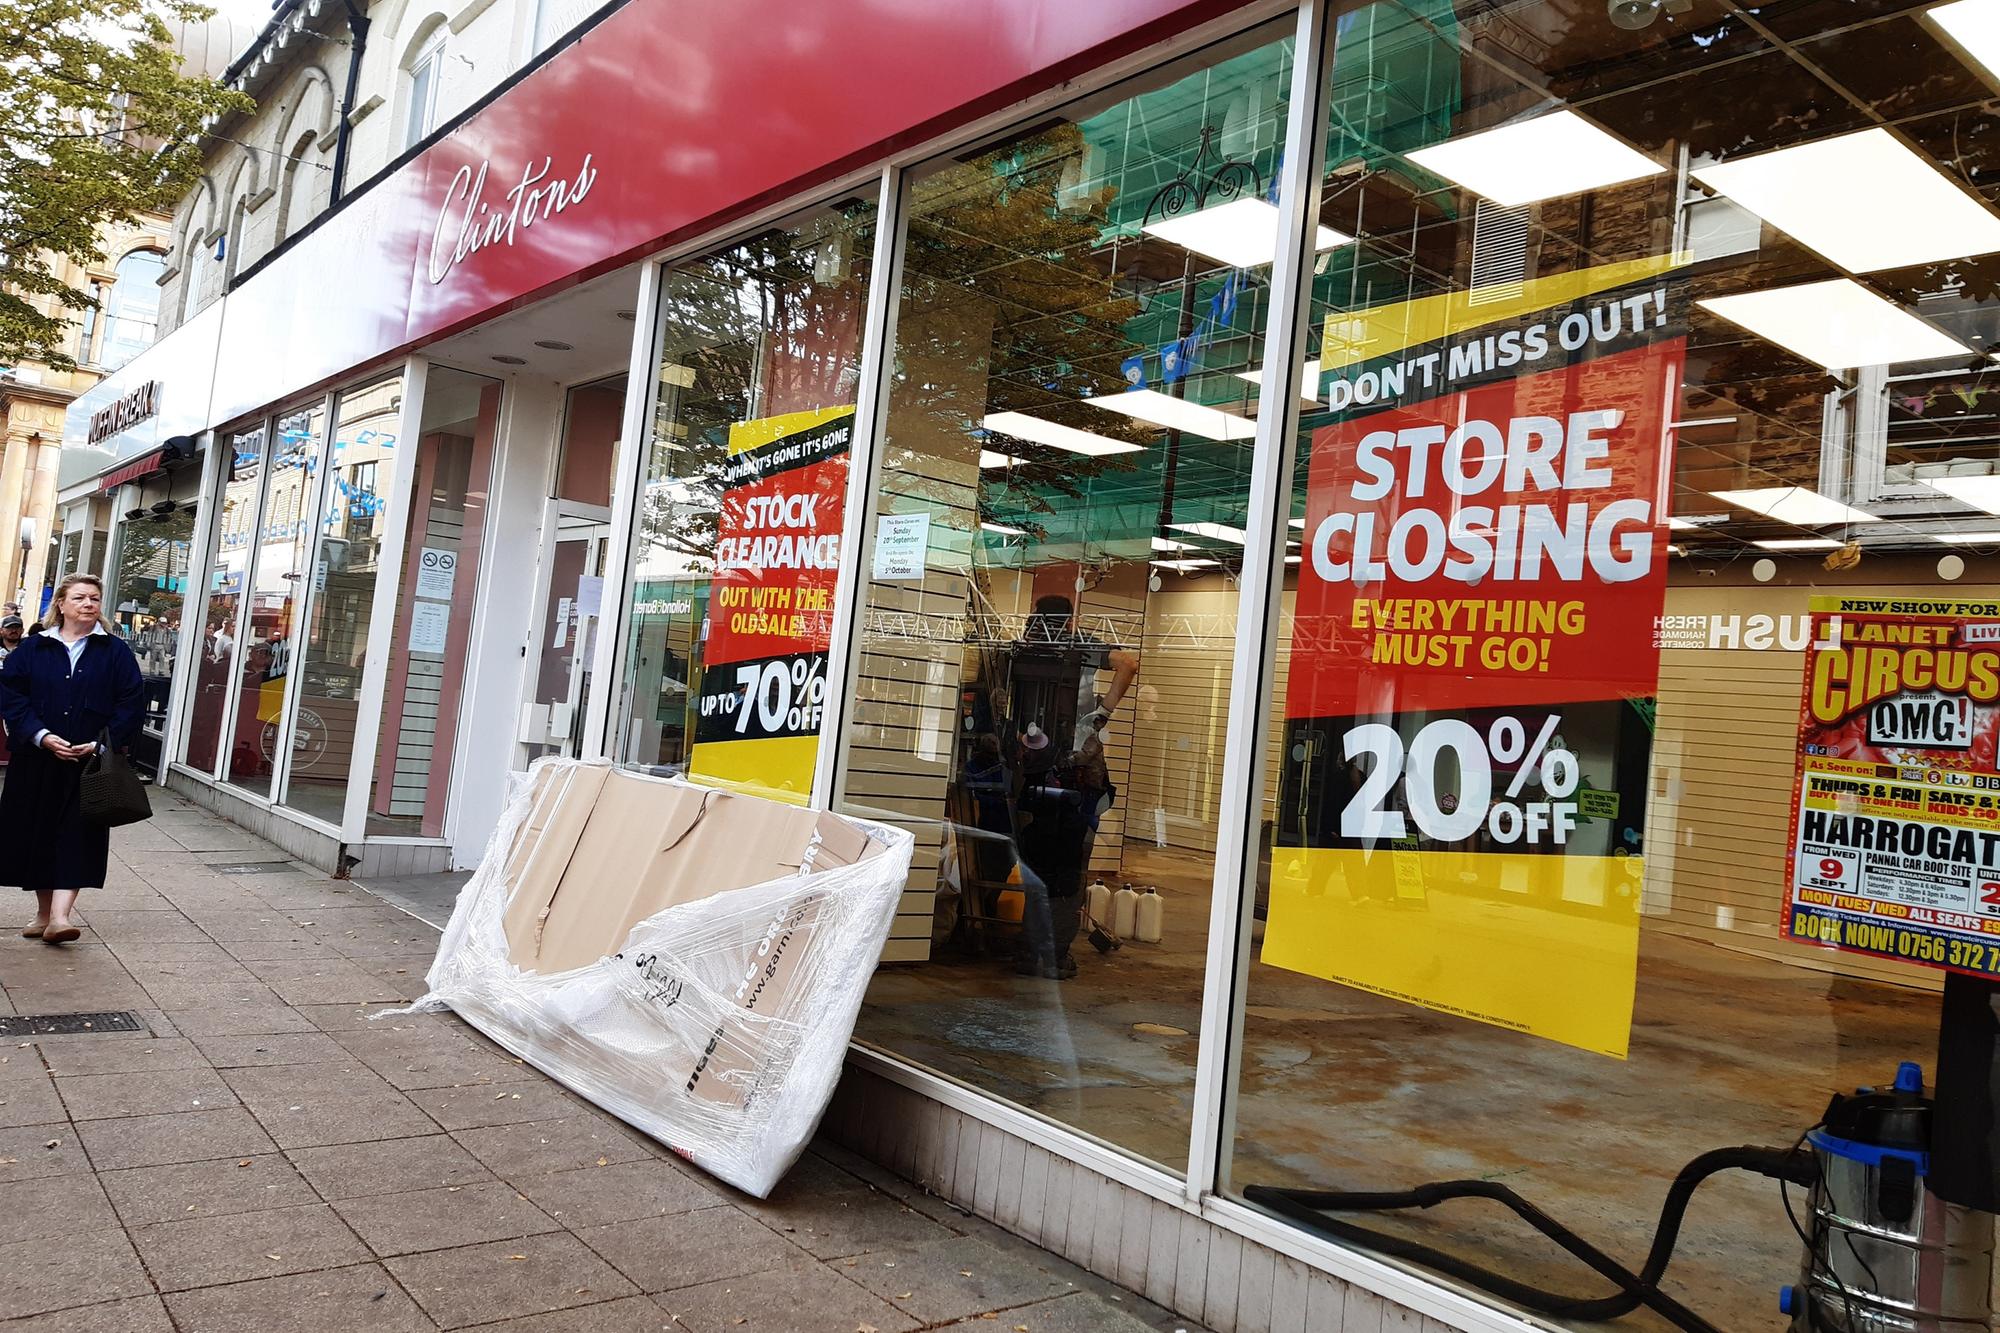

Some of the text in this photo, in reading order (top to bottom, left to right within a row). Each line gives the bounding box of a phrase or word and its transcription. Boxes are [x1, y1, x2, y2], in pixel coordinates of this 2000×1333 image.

[429, 153, 597, 284] Clintons
[1329, 288, 1666, 412] DON'T MISS OUT!
[727, 427, 849, 482] WHEN IT'S GONE IT'S GONE
[1351, 409, 1618, 500] STORE
[743, 493, 819, 529] STOCK
[893, 527, 911, 535] Sunday
[893, 536, 919, 544] September
[1311, 499, 1653, 582] CLOSING
[717, 534, 839, 570] CLEARANCE
[720, 586, 828, 610] OUT WITH THE
[1840, 600, 1999, 616] NEW SHOW FOR
[731, 612, 758, 634] OLD
[1351, 599, 1585, 635] EVERYTHING
[1820, 622, 1955, 645] PLANET
[1372, 635, 1551, 672] MUST GO!
[701, 657, 825, 733] UP TO 70%
[1812, 646, 1999, 722] CIRCUS
[1900, 693, 1937, 701] presents
[787, 705, 822, 731] OFF
[1875, 698, 1968, 741] OMG!
[1340, 715, 1578, 841] 20%
[1810, 761, 1823, 770] As
[1827, 762, 1853, 773] Seen
[1856, 767, 1873, 775] on:
[1945, 773, 1969, 785] itv
[1809, 791, 1830, 799] BUY
[1873, 798, 1894, 806] ONE
[1894, 801, 1920, 810] FREE
[1811, 778, 1921, 802] THURS & FRI
[1928, 791, 1975, 806] SATS
[1979, 797, 1993, 808] &
[1489, 803, 1577, 845] OFF
[1928, 803, 1998, 820] KIDS GO
[1803, 810, 2000, 866] HARROGAT
[1804, 845, 1856, 860] FROM WED
[1819, 858, 1843, 879] 9
[1866, 853, 1971, 878] PANNAL CAR BOOT SITE
[1872, 868, 1964, 886] PERFORMANCE TIMES
[1810, 878, 1848, 889] SEPT
[1810, 908, 1839, 919] Advance
[1840, 913, 1860, 923] Ticket
[1861, 917, 1880, 926] Sales
[1888, 921, 1927, 933] Information
[1909, 907, 1935, 923] ALL
[1937, 912, 1981, 930] SEATS
[1794, 912, 2000, 972] BOOK NOW! 0756 372 7
